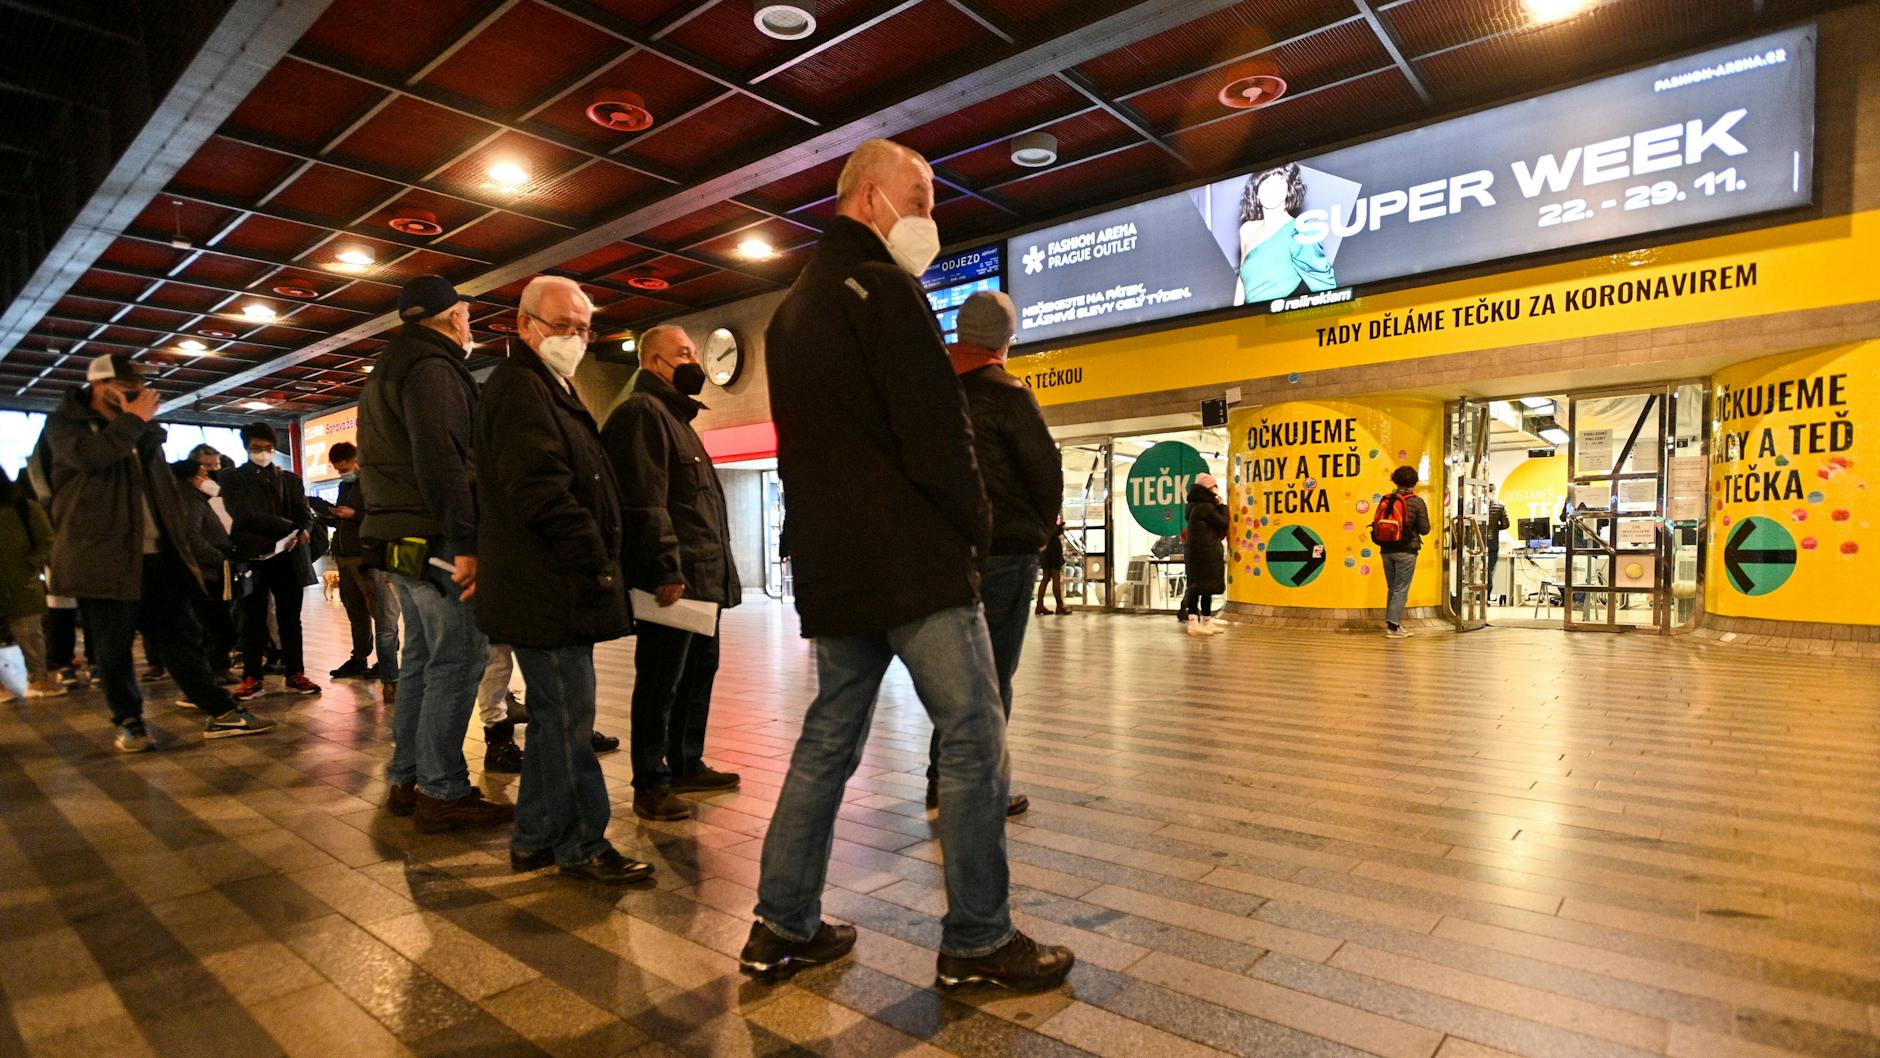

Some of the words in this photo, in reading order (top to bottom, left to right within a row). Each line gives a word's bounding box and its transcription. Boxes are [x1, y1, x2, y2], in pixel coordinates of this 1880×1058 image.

[1654, 48, 1787, 92] FASHION-ARENA.CZ
[1293, 169, 1497, 245] SUPER
[1511, 108, 1749, 199] WEEK
[1538, 204, 1595, 227] 22.
[1624, 180, 1686, 211] 29.
[1693, 166, 1747, 196] 11.
[1048, 232, 1096, 255] FASHION
[1097, 222, 1138, 243] ARENA
[1048, 248, 1091, 269] PRAGUE
[1093, 236, 1138, 257] OUTLET
[941, 252, 981, 271] ODJEZD
[1076, 299, 1116, 318] SLEVY
[1086, 290, 1105, 304] NA
[1316, 322, 1362, 348] TADY
[1369, 308, 1445, 340] DĚLÁME
[1452, 297, 1521, 328] TEČKU
[1529, 293, 1556, 317] ZA
[1565, 262, 1757, 312] KORONAVIREM
[1036, 367, 1083, 389] TEČKOU
[1247, 418, 1357, 450] OČKUJEME
[1758, 428, 1776, 458] A
[1788, 410, 1854, 455] TEĎ
[1244, 456, 1288, 483] TADY
[1295, 455, 1310, 479] A
[1318, 446, 1361, 478] TEĎ
[1129, 467, 1198, 507] TEČK
[1264, 483, 1330, 514] TEČKA
[1724, 464, 1804, 503] TEČKA
